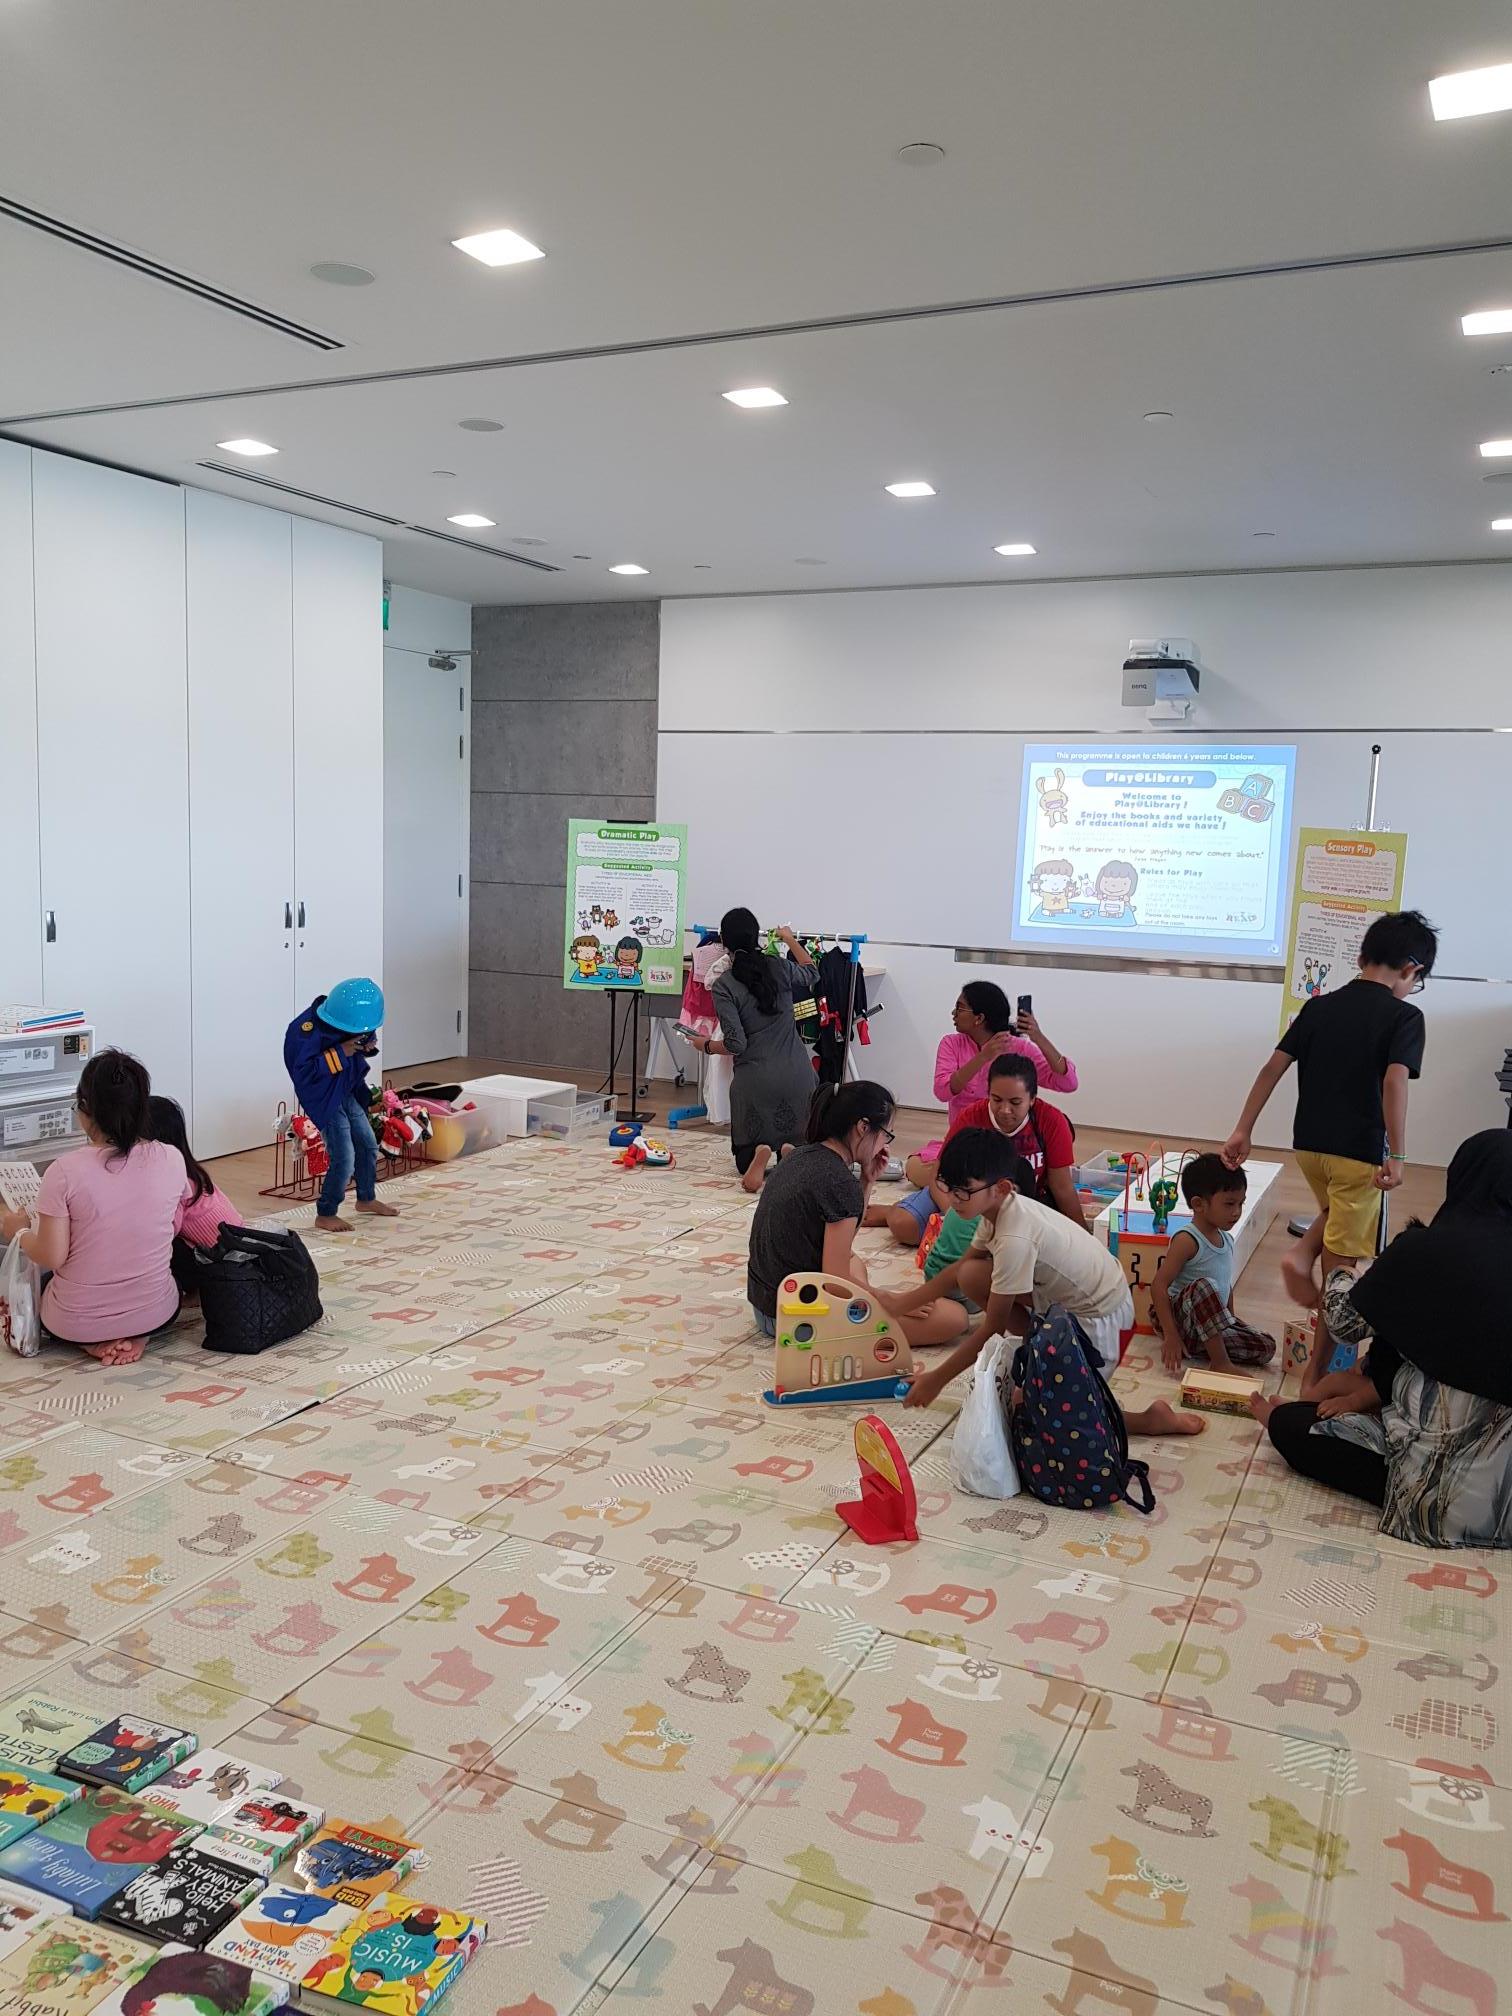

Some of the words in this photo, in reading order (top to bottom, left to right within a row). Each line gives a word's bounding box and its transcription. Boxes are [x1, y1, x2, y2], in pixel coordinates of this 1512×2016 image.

[1105, 772, 1194, 785] Play@Library
[1244, 780, 1259, 795] A
[1122, 792, 1167, 801] Welcome
[1171, 793, 1182, 801] to
[1224, 795, 1236, 808] B
[1080, 811, 1108, 820] Enjoy
[1111, 811, 1126, 820] the
[1130, 812, 1160, 821] books
[1164, 813, 1183, 821] and
[1187, 814, 1223, 823] variety
[1247, 805, 1260, 818] C
[1075, 819, 1088, 827] of
[1089, 819, 1148, 828] educational
[1151, 820, 1173, 829] aids
[1194, 822, 1219, 830] have
[601, 829, 637, 839] Dramatic
[639, 831, 657, 841] Play
[1207, 850, 1232, 858] comes
[1327, 842, 1355, 854] Sensory
[1357, 844, 1373, 855] Play
[1140, 867, 1164, 875] Rules
[1167, 868, 1180, 876] for
[1183, 869, 1203, 878] Play
[28, 1699, 60, 1712] Rabbit
[68, 1711, 85, 1720] Like
[86, 1716, 105, 1725] Run
[142, 1793, 180, 1812] WHO?
[343, 1841, 374, 1853] ABOUT
[376, 1851, 392, 1860] ALL
[41, 1859, 102, 1896] Lullaby
[173, 1858, 246, 1891] ANIMALS
[185, 1879, 235, 1903] BABY
[185, 1888, 225, 1913] Hello,
[335, 1892, 364, 1906] Bob
[244, 1939, 262, 1949] DAY
[224, 1941, 297, 1972] HAPPYLAND
[263, 1945, 289, 1958] RAINY
[354, 1943, 423, 1972] MUSIC
